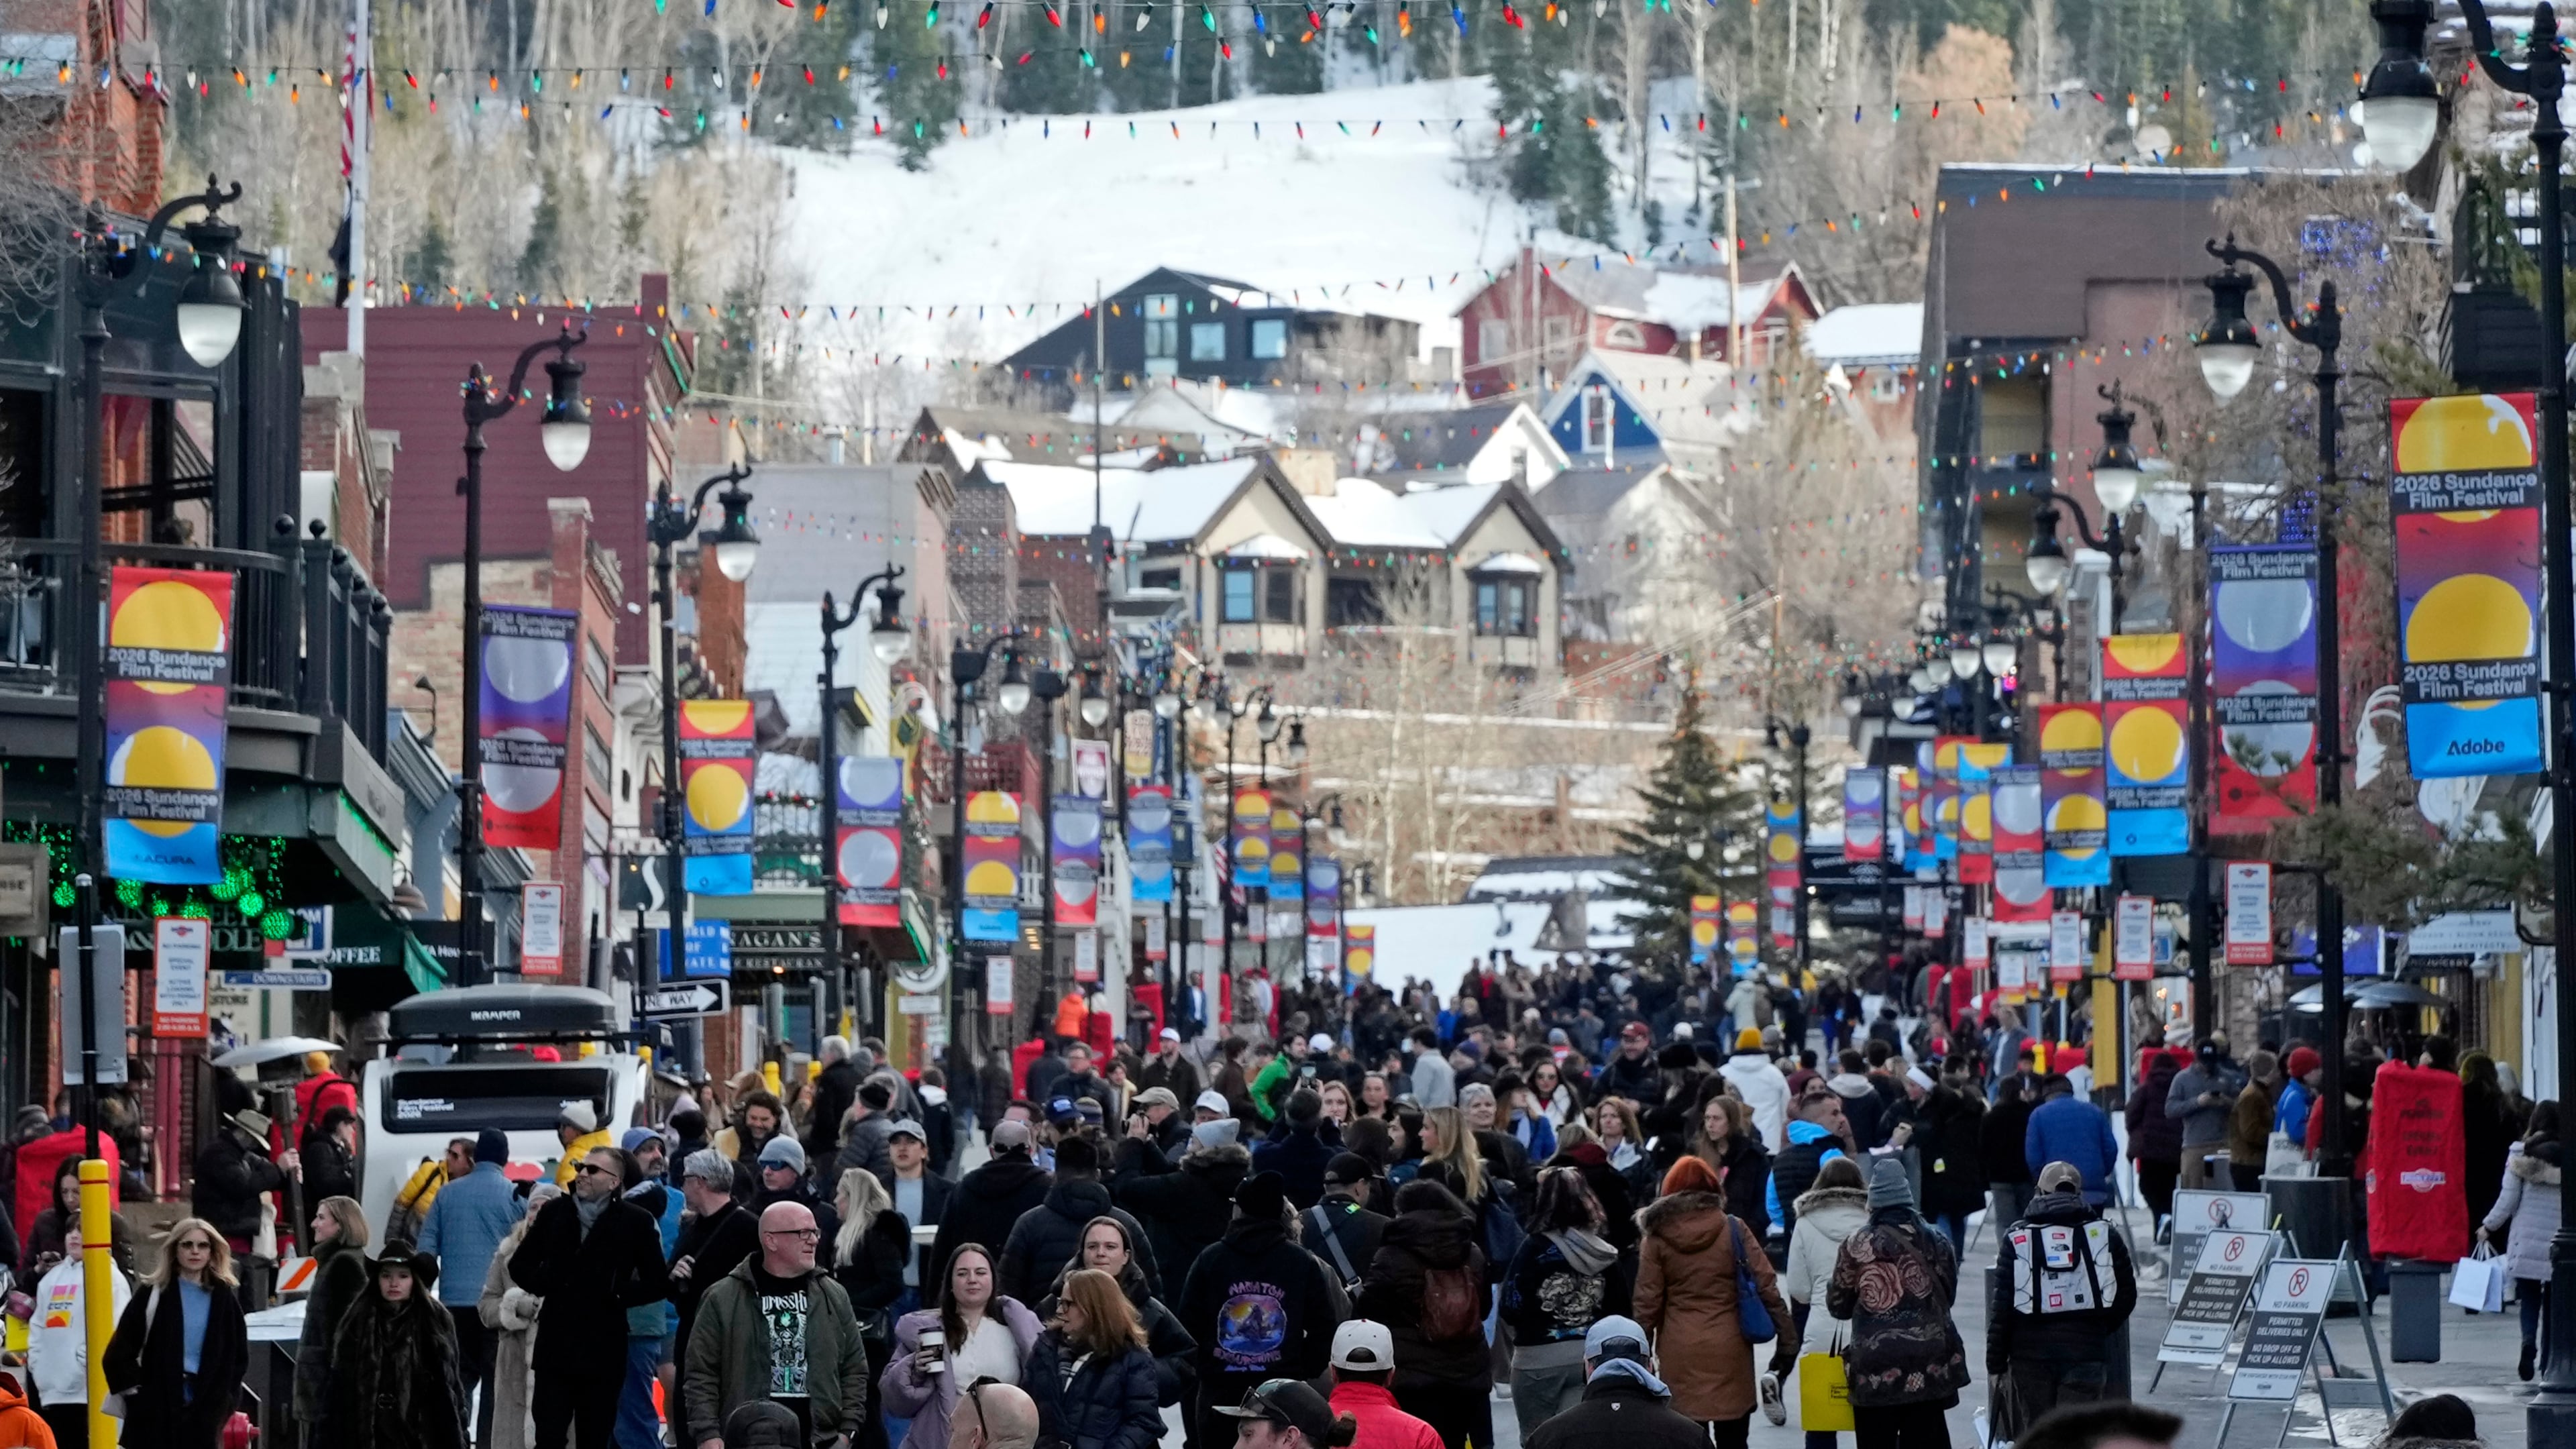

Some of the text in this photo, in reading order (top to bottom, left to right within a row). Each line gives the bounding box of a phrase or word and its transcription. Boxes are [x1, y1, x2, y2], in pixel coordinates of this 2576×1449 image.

[2394, 472, 2538, 493] 2026 Sundance
[2410, 488, 2524, 509] Film Festival
[2212, 551, 2317, 568] 2026 Sundance
[2222, 564, 2305, 578] Film Festival
[109, 647, 226, 668] 2026 Sundance
[119, 662, 215, 681] Film Festival
[2404, 661, 2536, 682] 2026 Sundance
[2419, 676, 2526, 698] Film Festival
[2447, 739, 2505, 755] Adobe
[107, 788, 219, 806] 2026 Sundance
[117, 803, 206, 820] Film Festival
[668, 992, 694, 1005] WAY
[2204, 1277, 2237, 1287] PERMITTED
[2192, 1285, 2224, 1295] DELIVERIES
[2282, 1301, 2310, 1309] PARKING
[2204, 1310, 2231, 1320] ALLOWED
[2268, 1316, 2304, 1326] PERMITTED
[2257, 1326, 2308, 1337] DELIVERIES ONLY
[2251, 1343, 2302, 1354] NO DROP OFF OR
[2246, 1354, 2300, 1365] PICK UP ALLOWED
